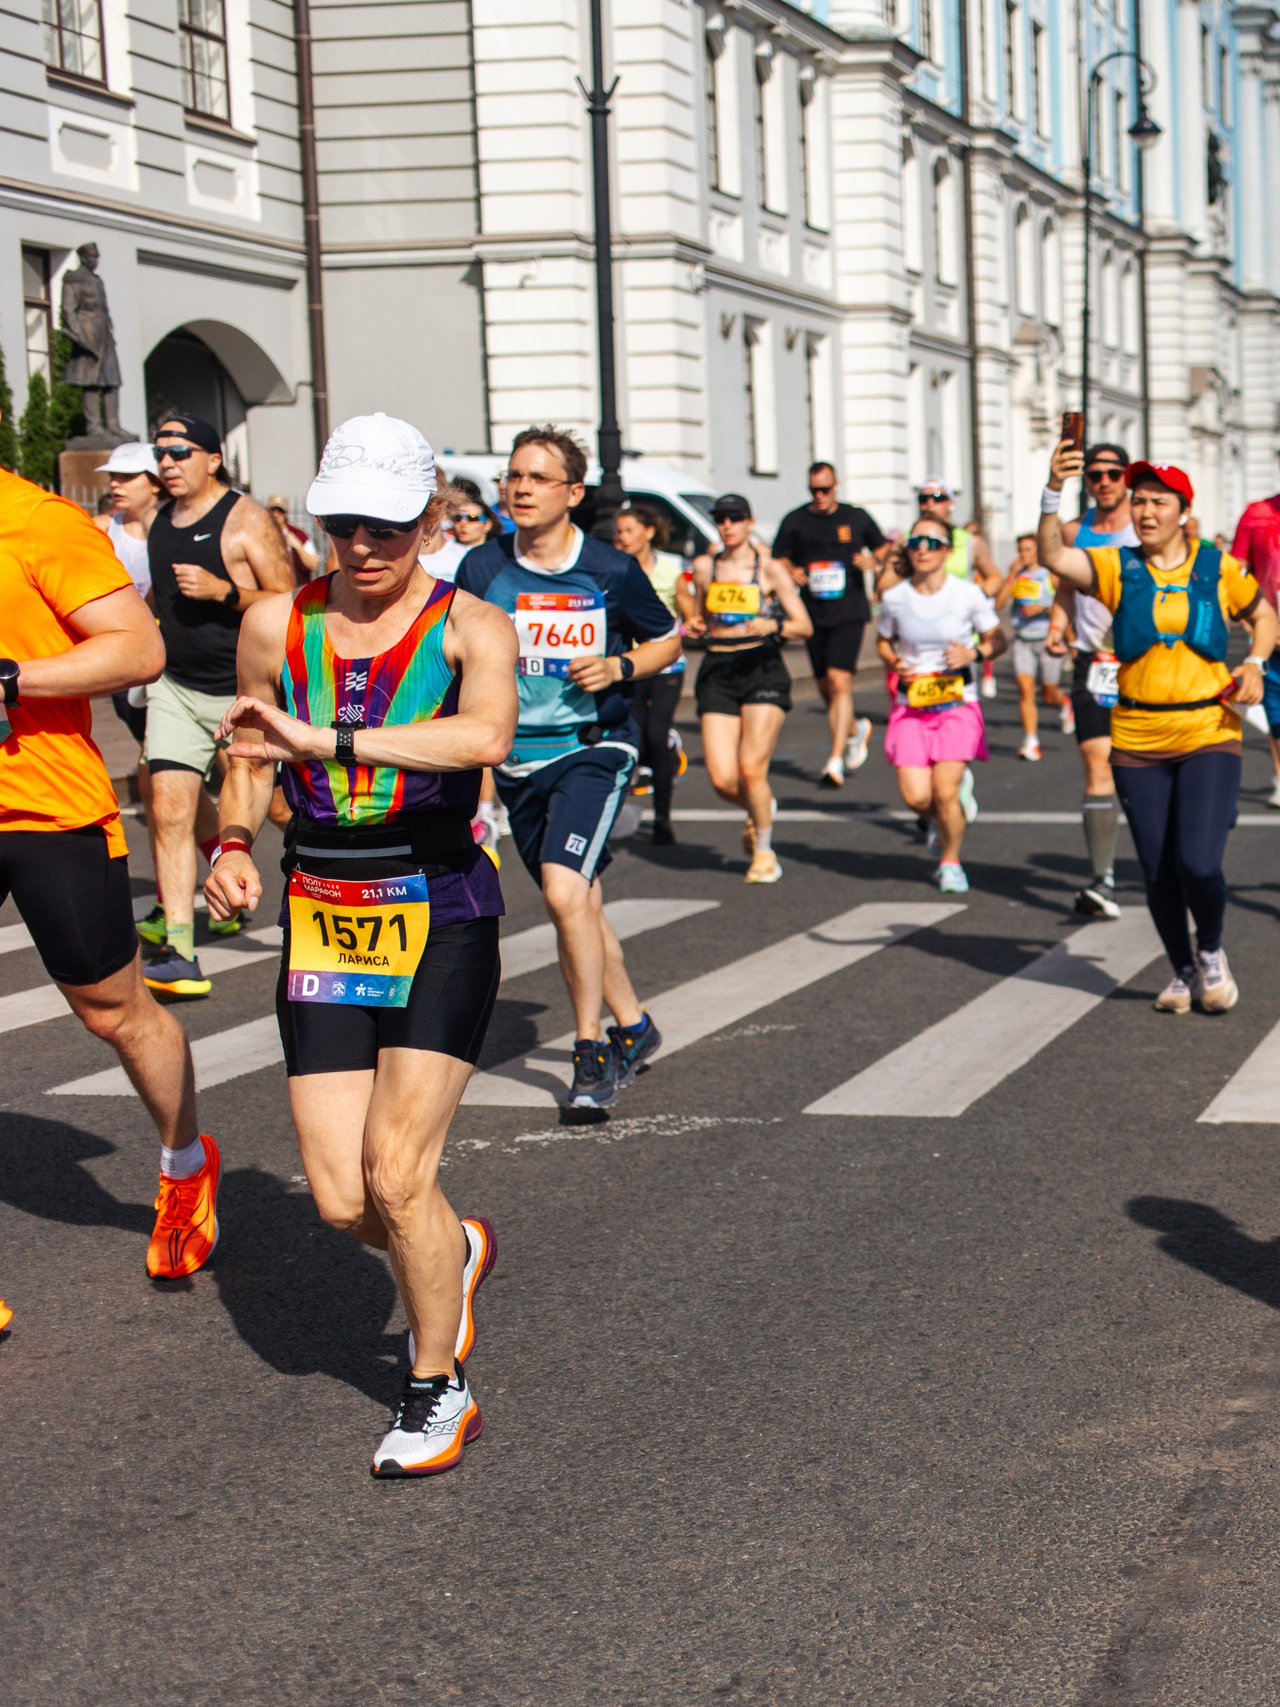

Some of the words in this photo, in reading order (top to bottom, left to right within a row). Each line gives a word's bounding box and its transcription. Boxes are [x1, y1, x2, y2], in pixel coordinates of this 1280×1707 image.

[716, 589, 746, 603] 474
[528, 622, 595, 648] 7640
[530, 660, 541, 673] D
[303, 883, 342, 898] МАРАФОН
[361, 888, 384, 899] 21,1
[312, 910, 408, 952] 1571
[337, 952, 390, 967] ЛАРИСА
[301, 974, 320, 997] D
